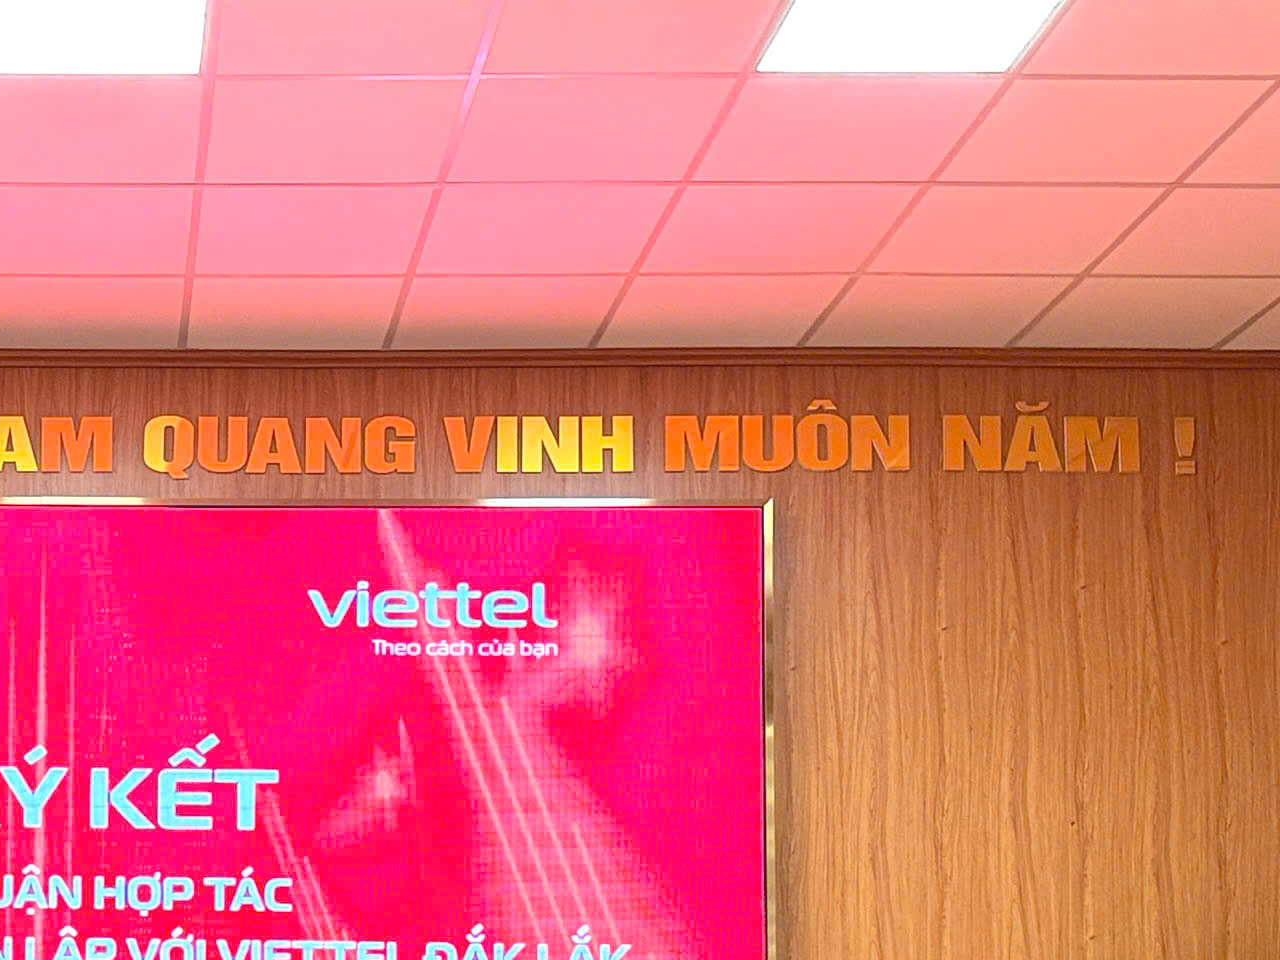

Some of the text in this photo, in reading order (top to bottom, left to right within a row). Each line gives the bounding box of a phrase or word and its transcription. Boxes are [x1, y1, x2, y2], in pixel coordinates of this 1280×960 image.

[143, 415, 417, 479] QUANG
[443, 415, 635, 474] VINH
[664, 400, 910, 473] MUÔN
[942, 401, 1141, 474] NĂM
[1174, 416, 1196, 475] !
[307, 581, 558, 628] viettel
[371, 639, 558, 660] Theo cách của bạn
[89, 733, 279, 831] KẾT
[94, 871, 195, 917] HỢP
[204, 866, 293, 912] TÁC
